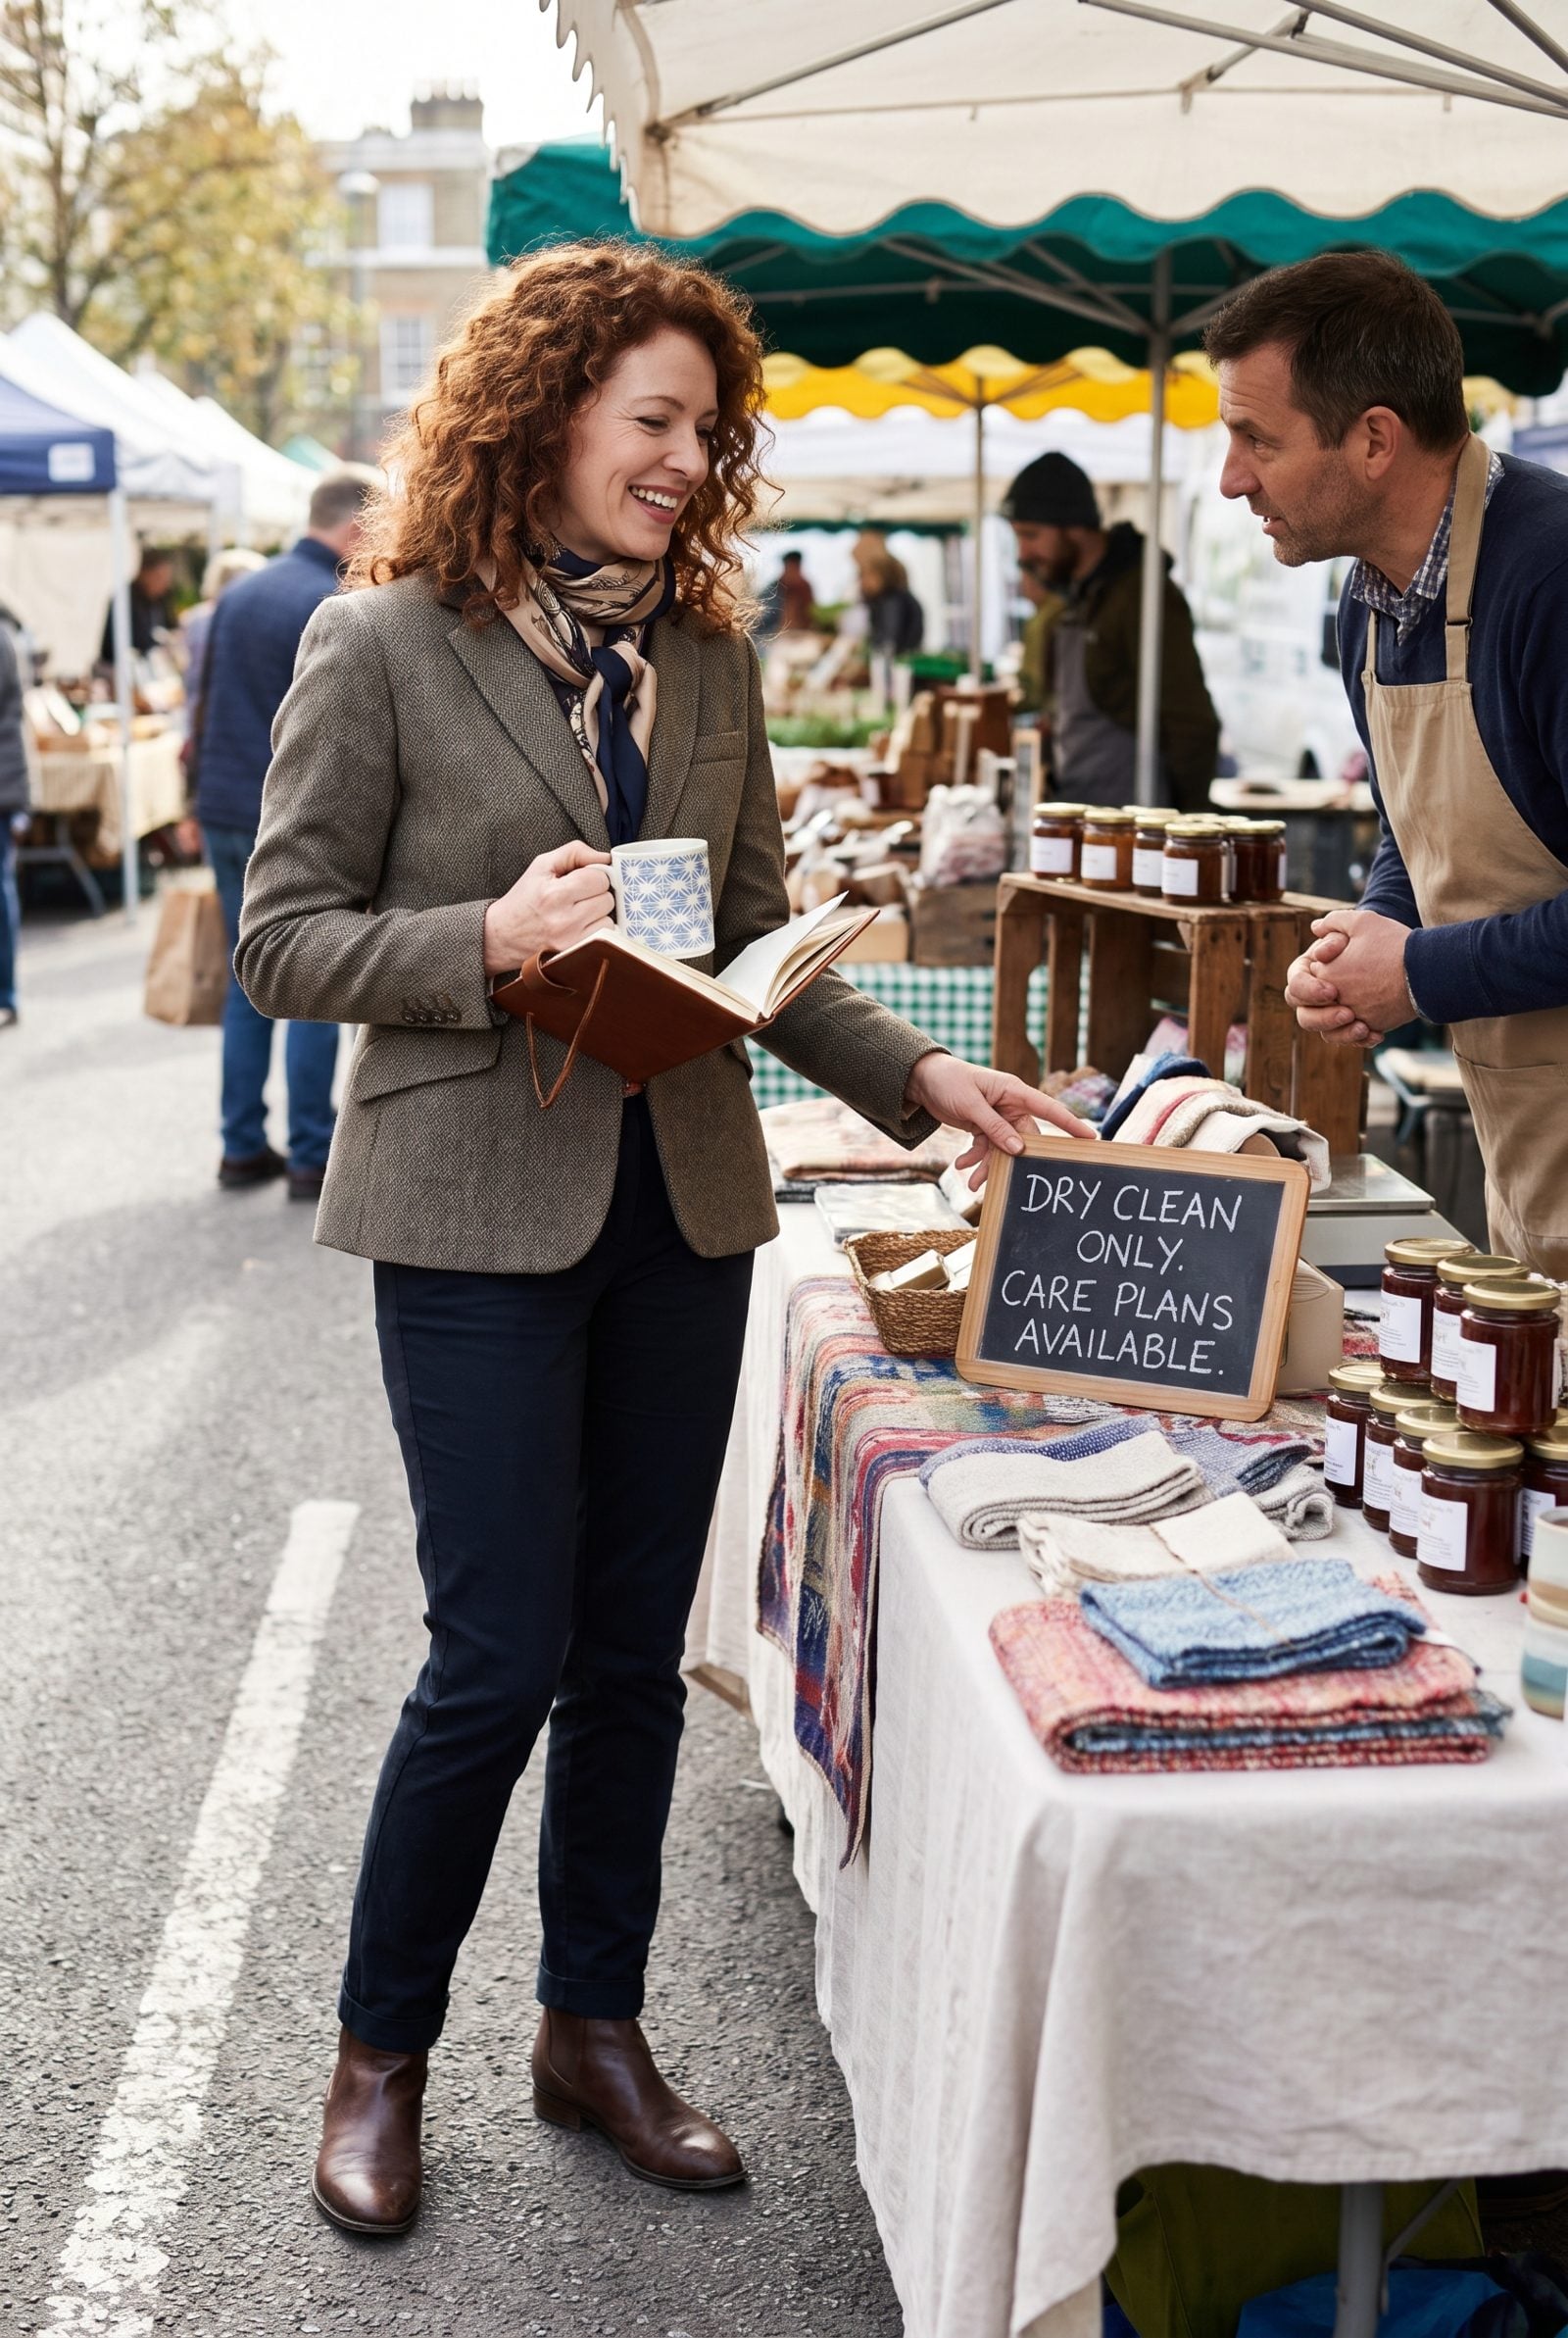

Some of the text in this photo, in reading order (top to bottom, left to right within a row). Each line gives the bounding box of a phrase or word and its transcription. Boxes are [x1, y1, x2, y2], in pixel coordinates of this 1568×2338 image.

[1021, 1173, 1243, 1232] DRY CLEAN
[1077, 1230, 1184, 1274] ONLY.
[1002, 1269, 1234, 1331] CARE PLANS
[1014, 1318, 1224, 1374] AVAILABLE.
